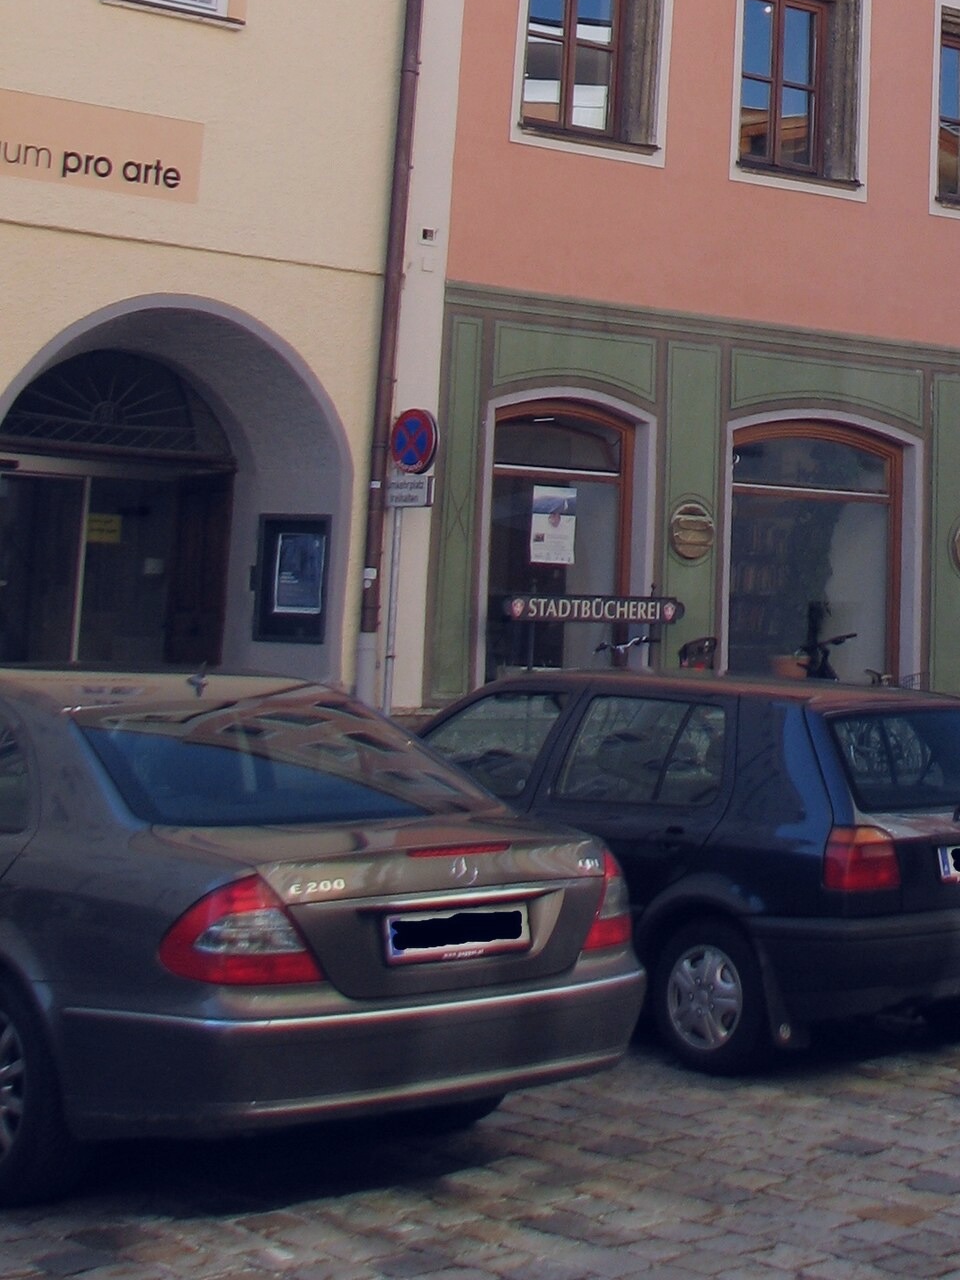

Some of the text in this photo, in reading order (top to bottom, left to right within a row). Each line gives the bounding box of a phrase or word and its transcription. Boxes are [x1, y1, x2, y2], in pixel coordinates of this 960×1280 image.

[0, 141, 182, 189] um pro arte
[527, 597, 661, 620] STADTBÜCHEREI
[289, 878, 346, 895] E 200
